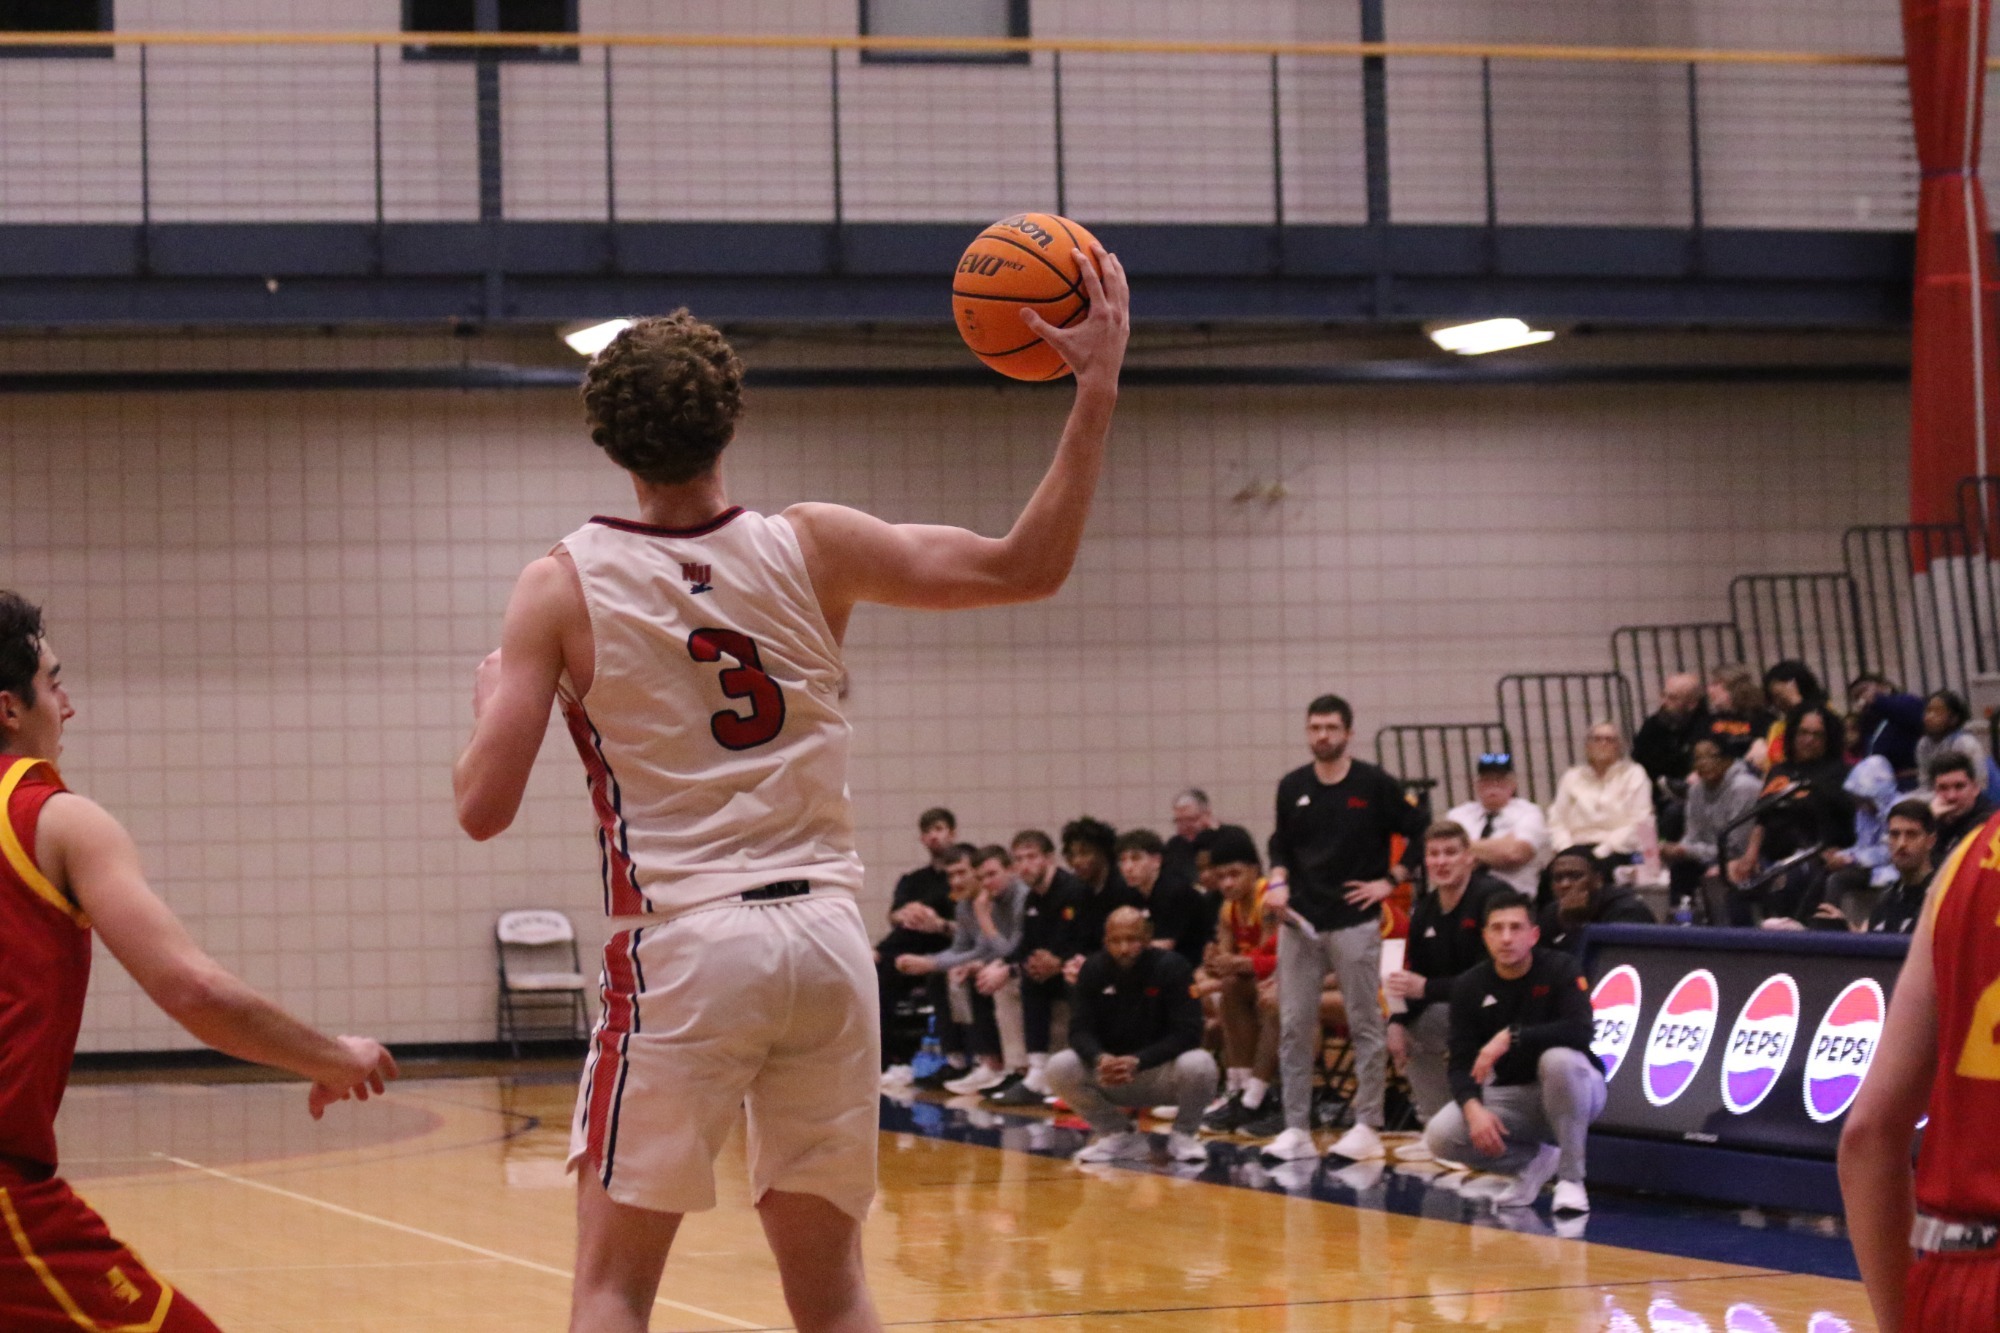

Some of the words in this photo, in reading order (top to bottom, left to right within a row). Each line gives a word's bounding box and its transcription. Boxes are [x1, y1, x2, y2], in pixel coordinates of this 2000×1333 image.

[958, 254, 1005, 277] EVO
[687, 627, 786, 751] 3
[1593, 1018, 1631, 1045] EPSI
[1653, 1023, 1708, 1052] PEPSI
[1732, 1029, 1790, 1059] PEPSI
[1814, 1034, 1875, 1066] PEPSI
